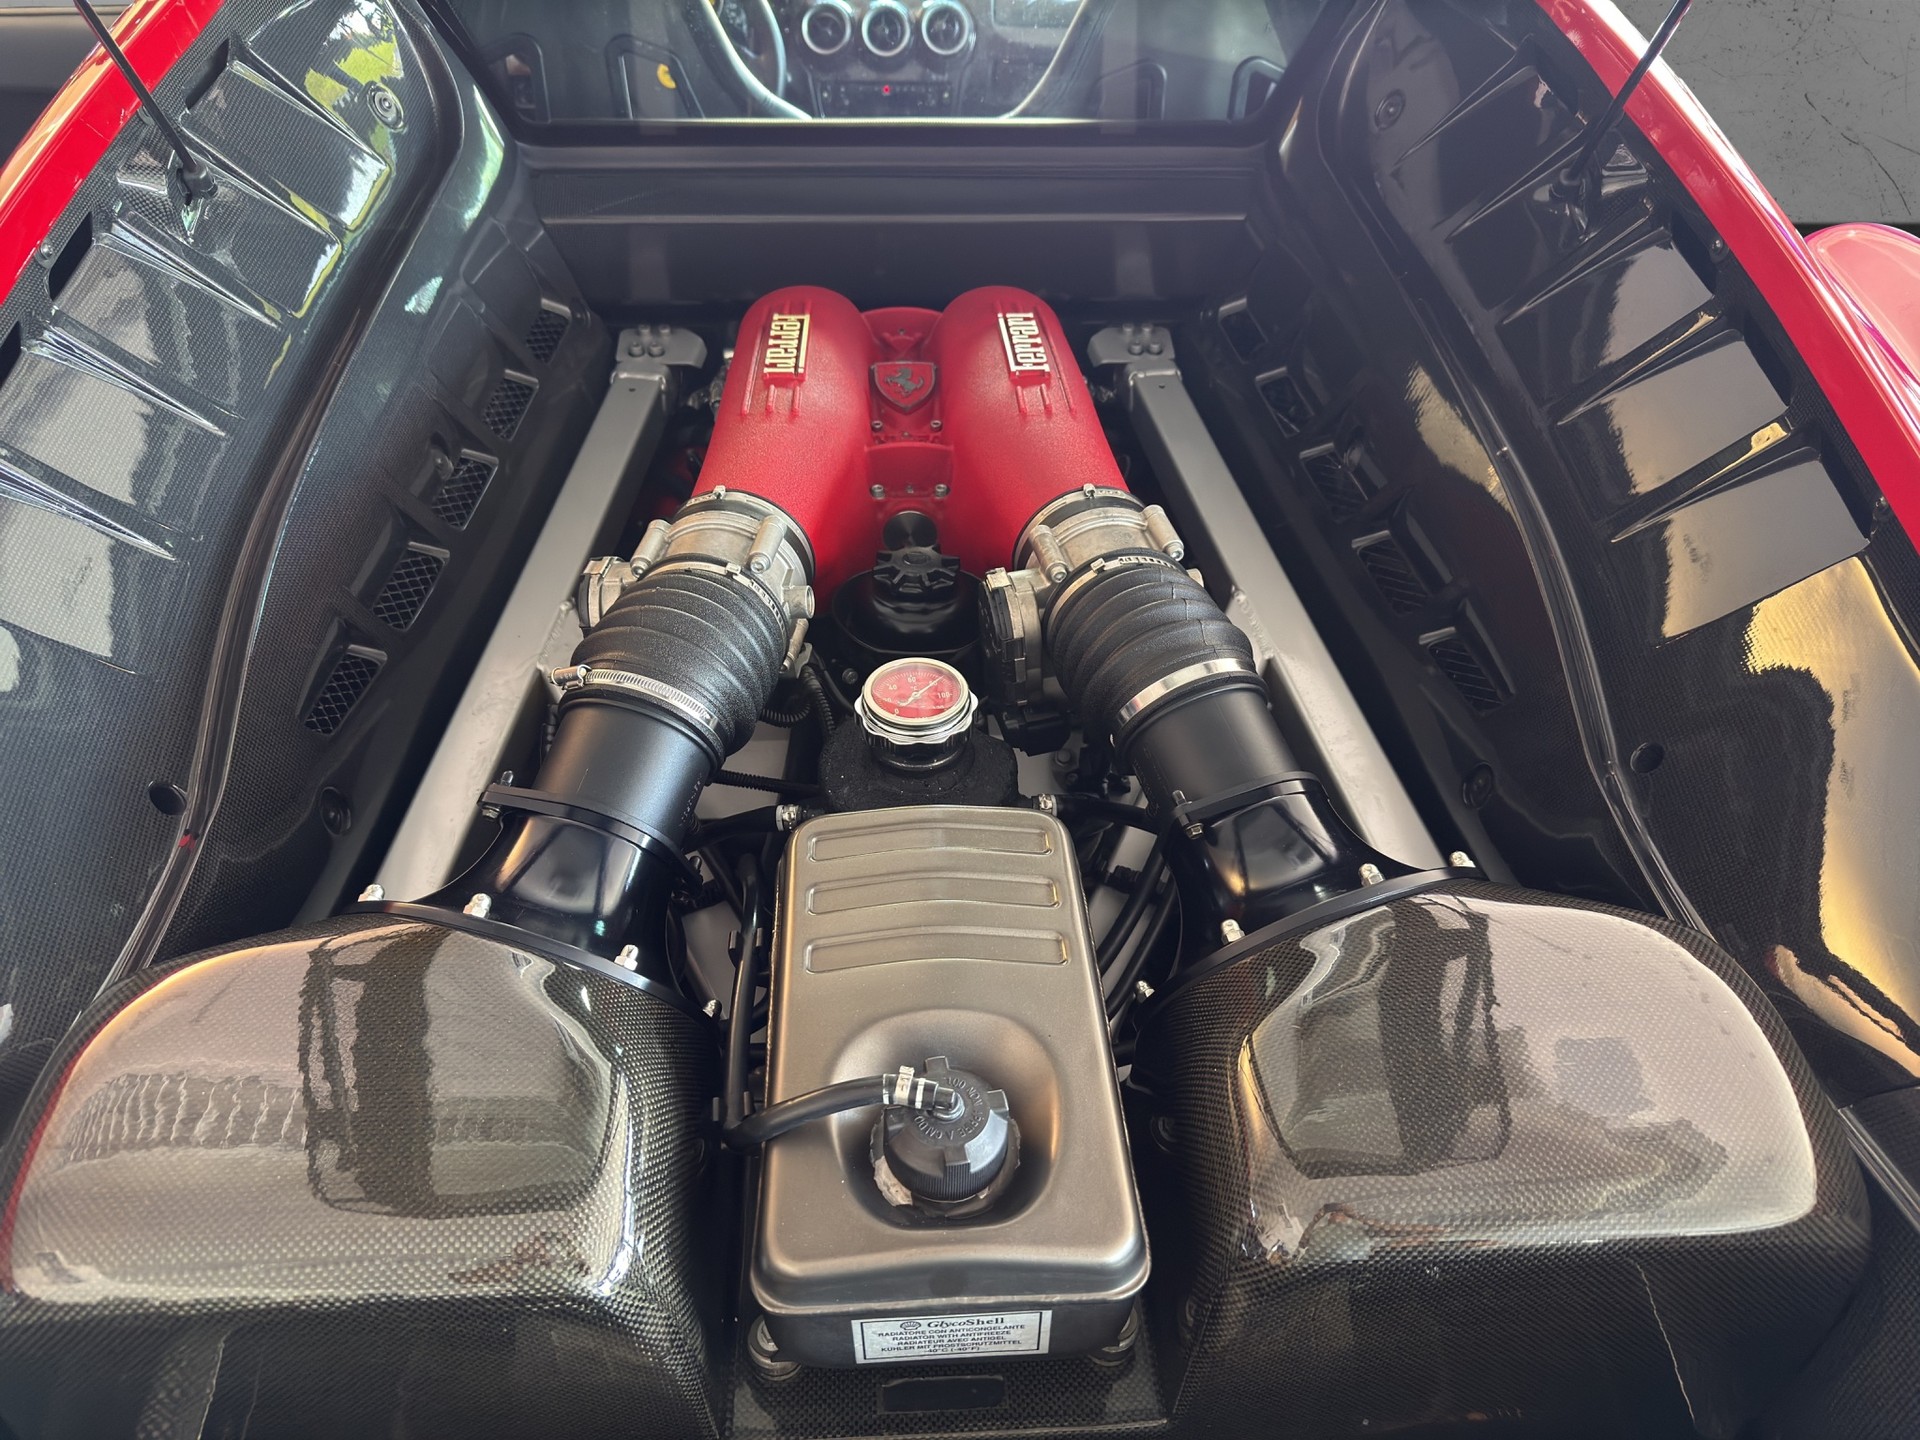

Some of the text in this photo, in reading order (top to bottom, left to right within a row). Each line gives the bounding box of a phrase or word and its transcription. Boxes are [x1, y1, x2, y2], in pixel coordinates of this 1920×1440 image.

[763, 312, 810, 374] Ferrari
[997, 312, 1051, 373] Ferrari
[927, 1317, 1005, 1329] GlycoShell
